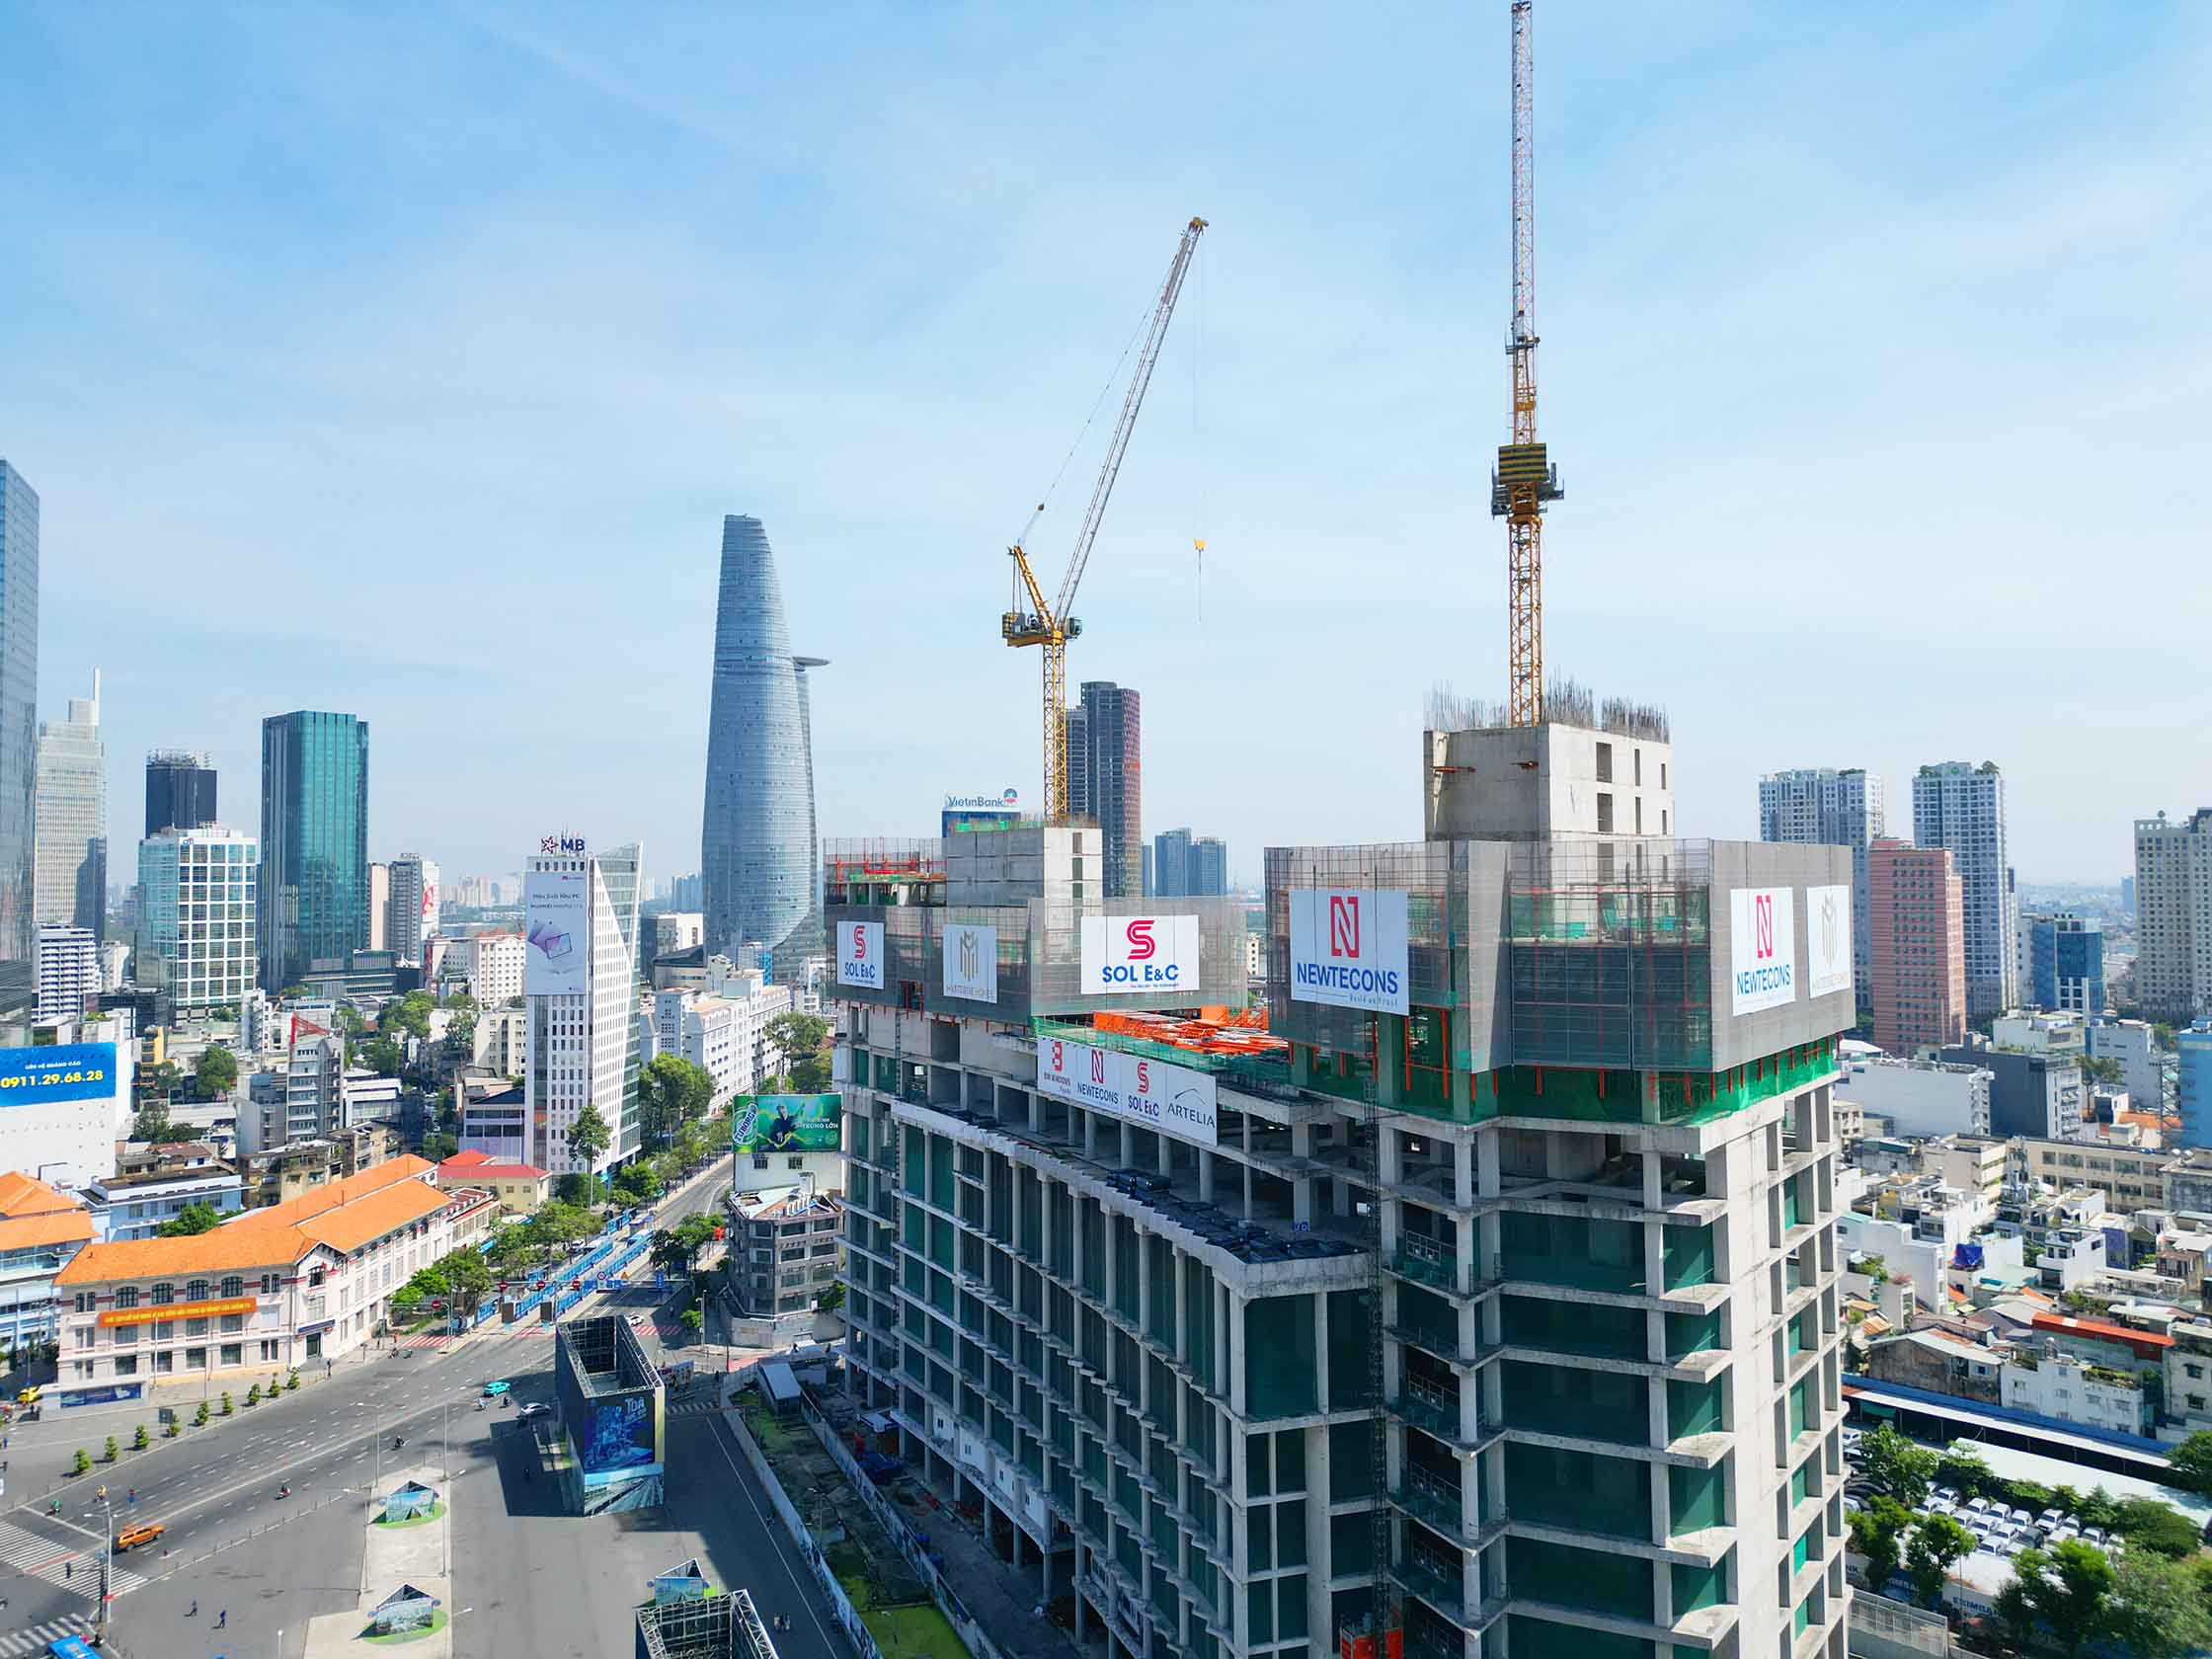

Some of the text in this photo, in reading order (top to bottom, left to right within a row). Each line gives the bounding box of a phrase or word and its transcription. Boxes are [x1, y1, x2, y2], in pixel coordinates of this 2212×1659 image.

[948, 796, 1004, 807] VietinBank
[561, 838, 585, 851] MB
[844, 962, 876, 979] SOL E&C
[1102, 964, 1179, 983] SOL E&C
[1297, 962, 1398, 994] NEWTECONS
[1737, 964, 1791, 995] NEWTECONS
[0, 1070, 104, 1088] 0911.29.68.28
[1077, 1082, 1119, 1104] NEWTECONS
[1129, 1095, 1159, 1116] SOL E&C
[1167, 1103, 1216, 1128] ARTELIA
[734, 1105, 757, 1141] TUBORG
